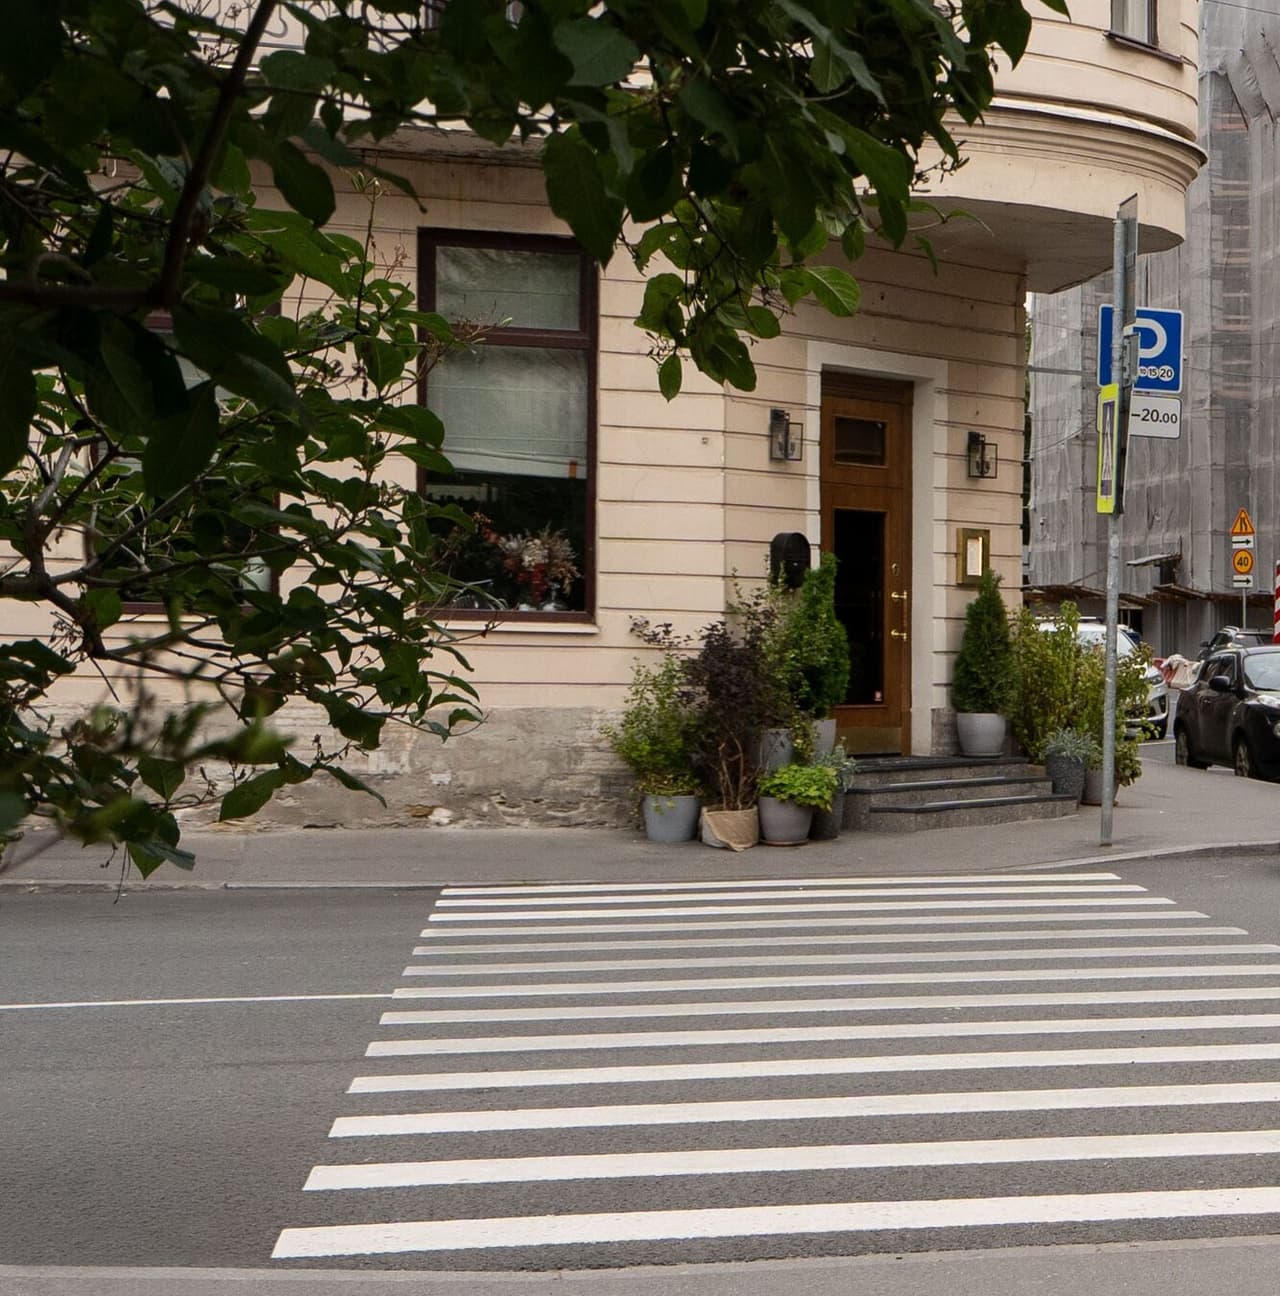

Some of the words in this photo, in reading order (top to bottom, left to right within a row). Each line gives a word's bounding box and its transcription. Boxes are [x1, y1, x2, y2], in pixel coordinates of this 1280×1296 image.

[1149, 368, 1158, 376] 15
[1160, 368, 1173, 378] 20
[1236, 556, 1249, 567] 40
